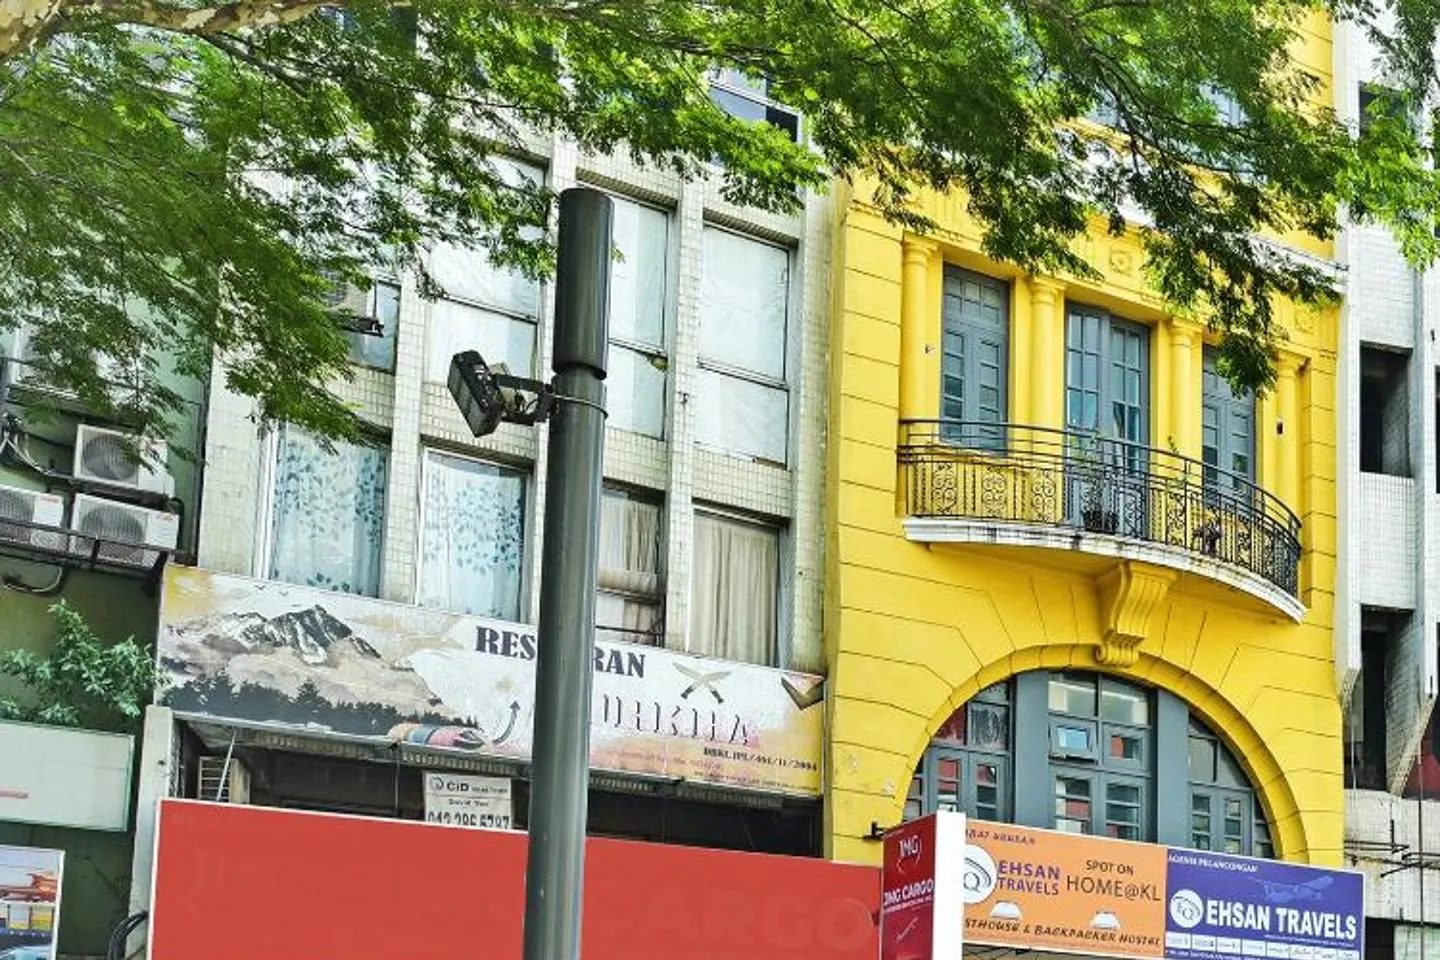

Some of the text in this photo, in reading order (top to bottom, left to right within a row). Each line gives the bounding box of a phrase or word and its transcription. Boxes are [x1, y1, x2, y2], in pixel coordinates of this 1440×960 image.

[475, 626, 645, 678] RESRAN
[999, 860, 1060, 880] EHSAN
[1085, 859, 1134, 876] SPOT ON
[997, 877, 1060, 896] TRAVELS
[1066, 875, 1161, 901] HOME@KL
[965, 918, 1019, 932] STHOUSE
[1034, 925, 1117, 943] BACKPACKER
[1206, 899, 1357, 940] EHSAN TRAVELS
